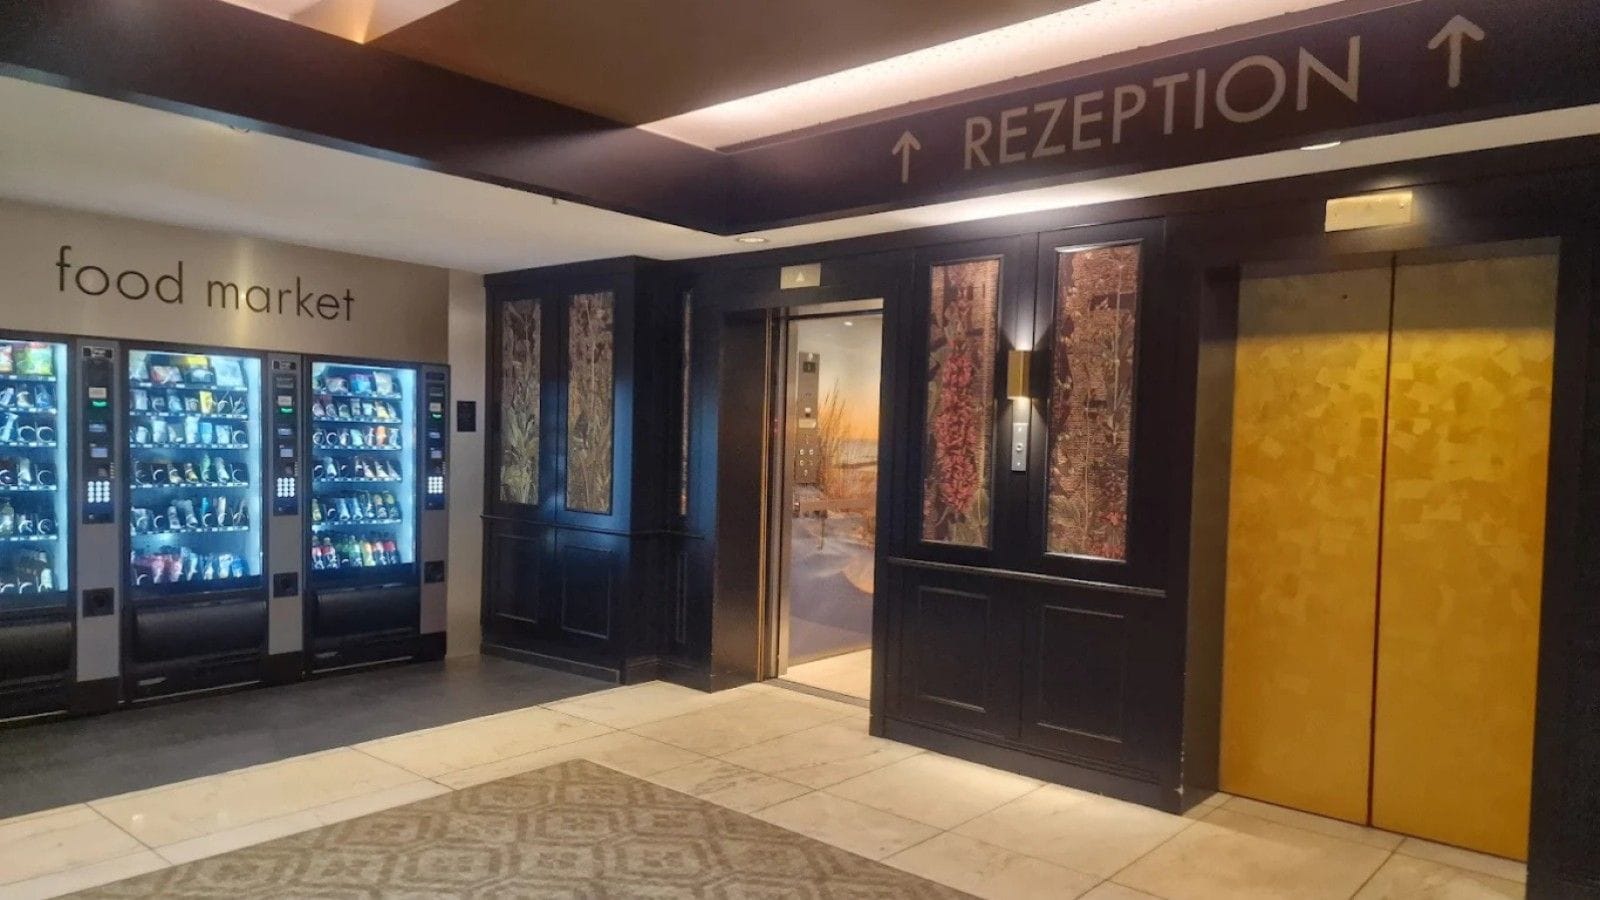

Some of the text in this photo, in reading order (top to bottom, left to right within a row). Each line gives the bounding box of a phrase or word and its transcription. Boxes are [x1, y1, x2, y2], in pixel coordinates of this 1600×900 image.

[964, 35, 1361, 170] REZEPTION
[56, 245, 355, 322] food market
